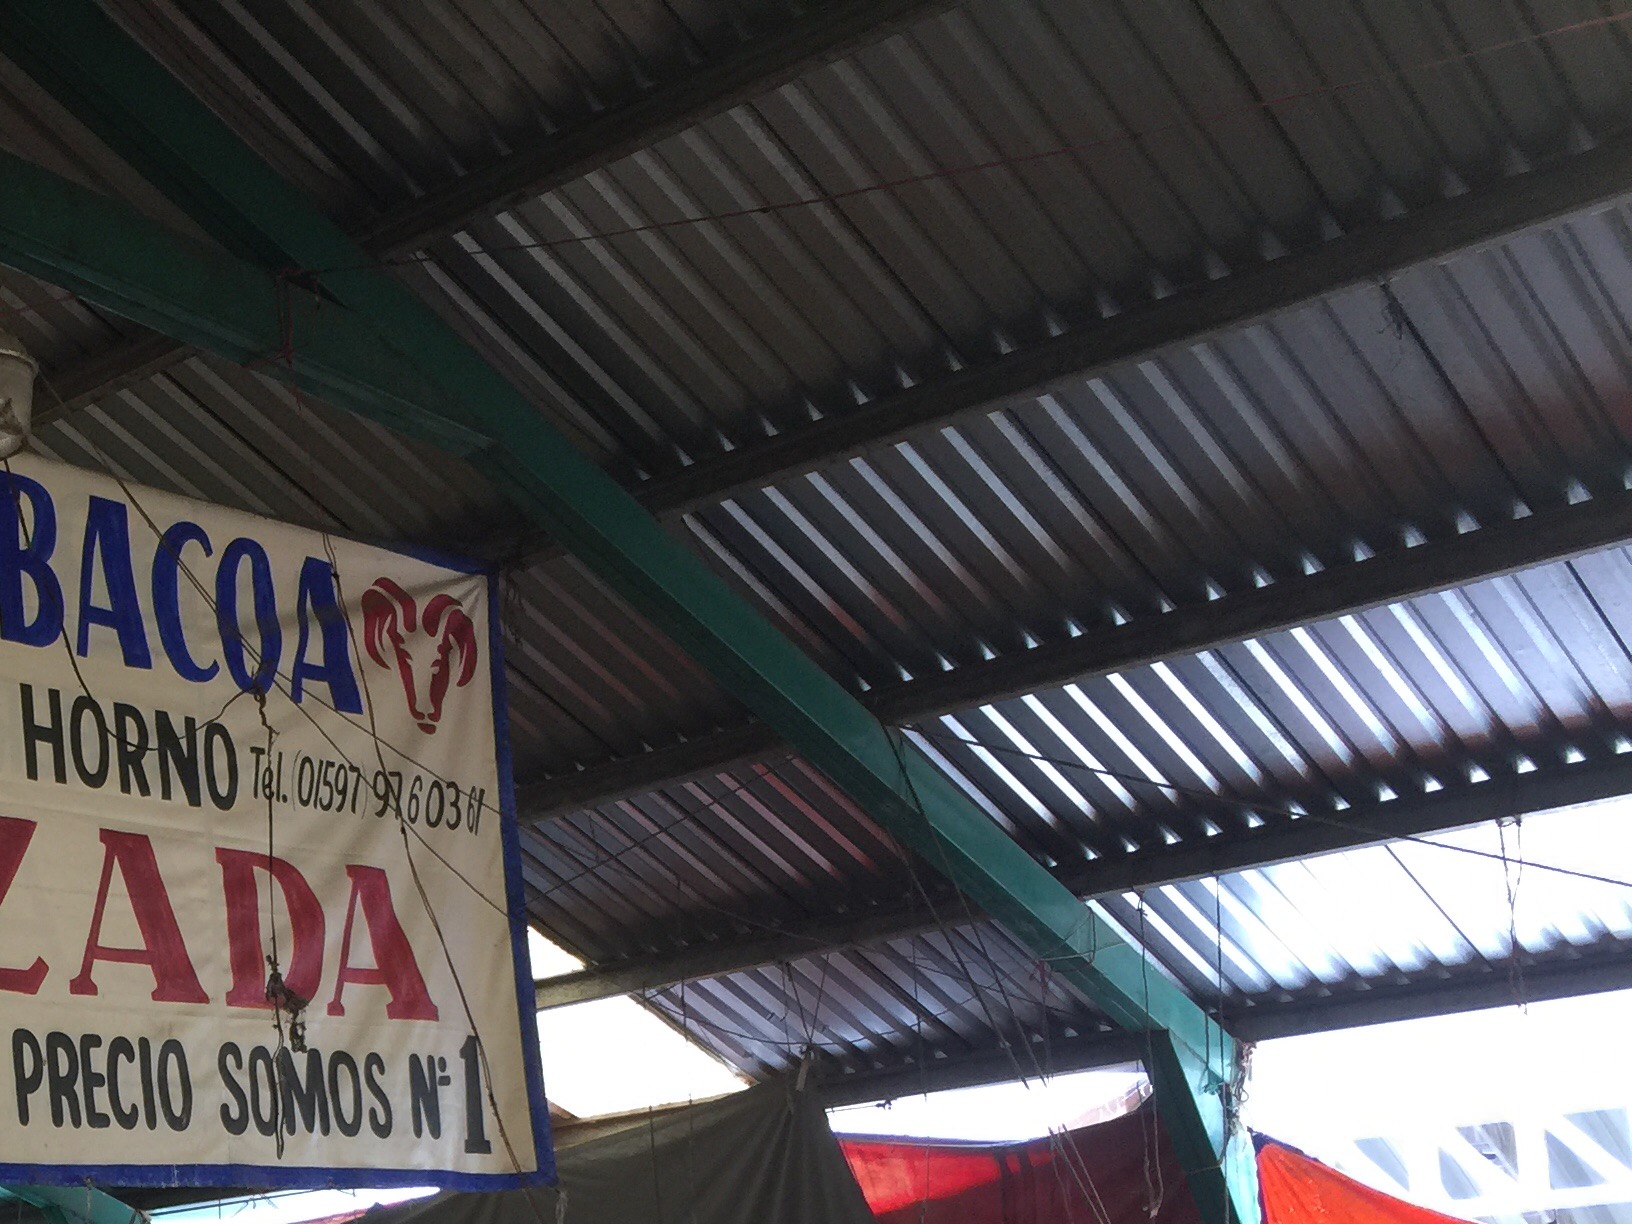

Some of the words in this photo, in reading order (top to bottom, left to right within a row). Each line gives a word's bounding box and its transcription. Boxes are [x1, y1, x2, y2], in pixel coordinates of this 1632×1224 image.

[19, 682, 239, 811] HORNO
[250, 746, 288, 803] Tel.
[12, 1028, 194, 1132] PRECIO
[218, 1041, 393, 1140] SOMOS
